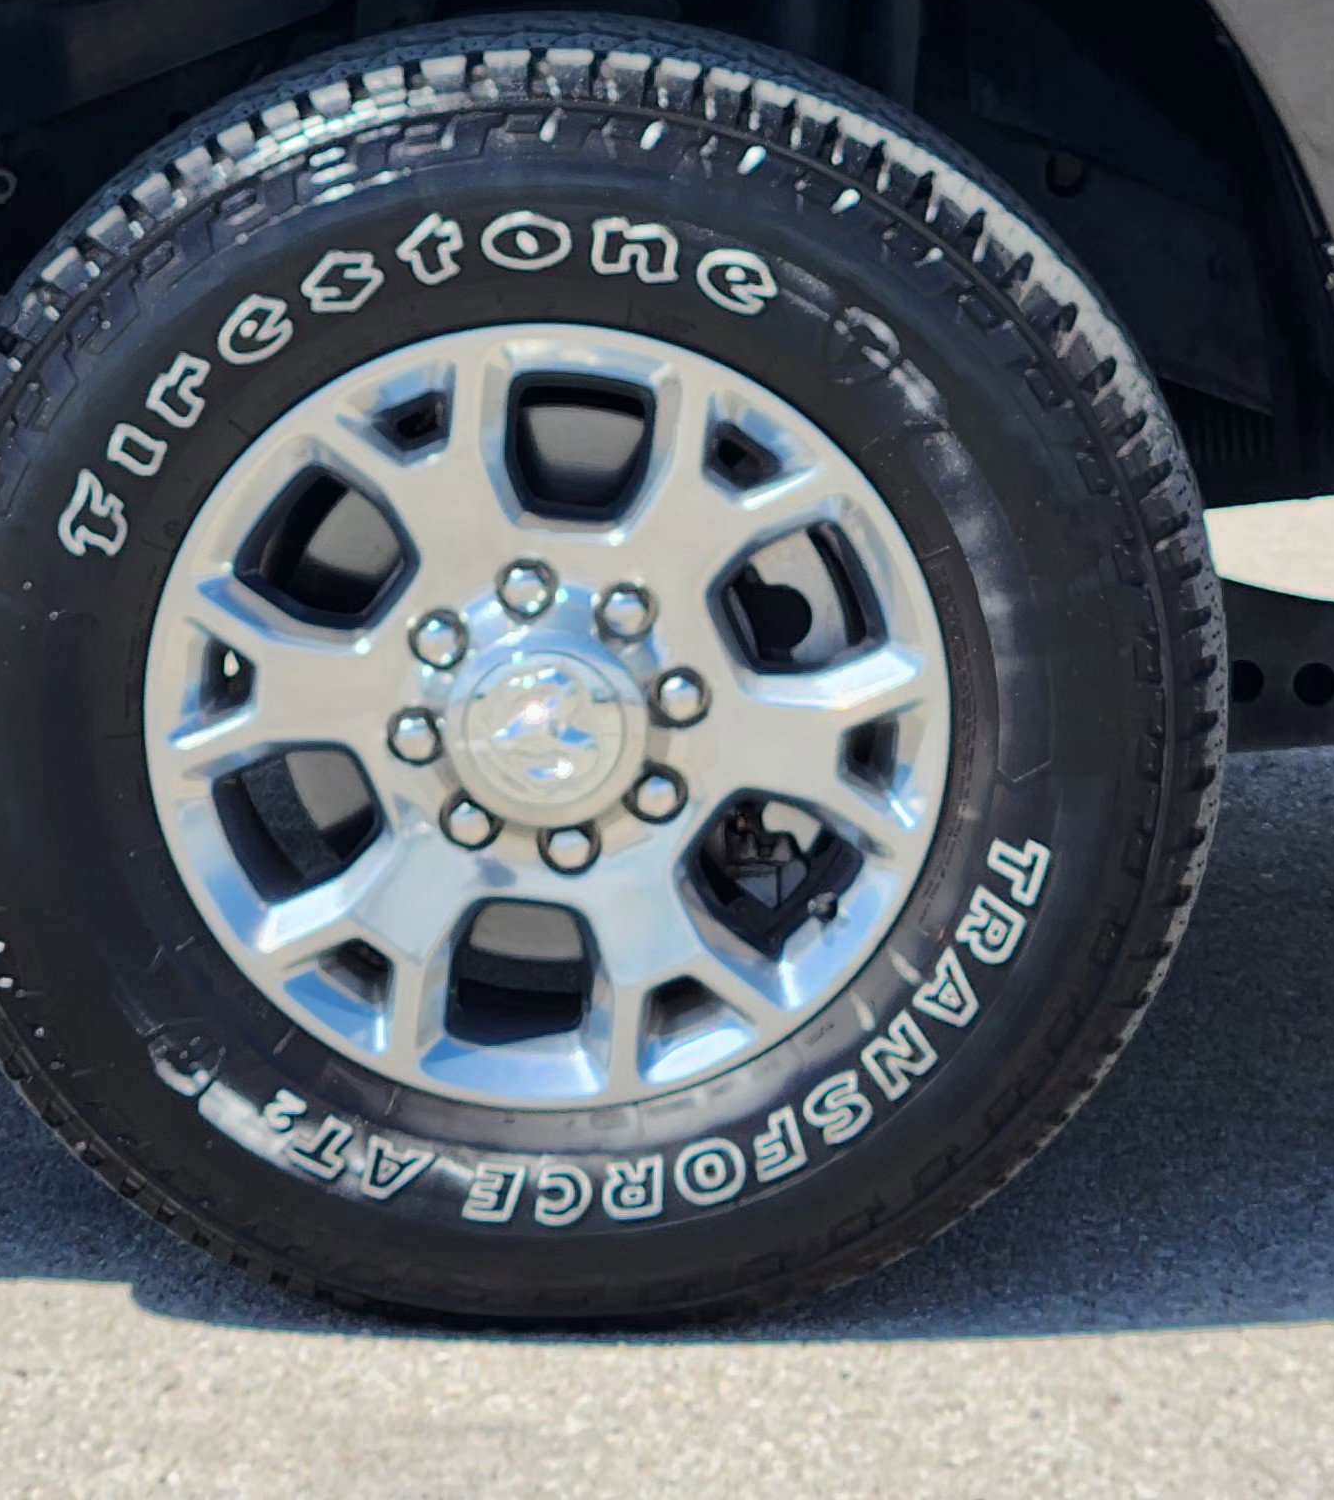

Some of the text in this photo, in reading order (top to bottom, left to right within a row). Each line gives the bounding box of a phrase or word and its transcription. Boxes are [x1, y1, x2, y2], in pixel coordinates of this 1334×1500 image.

[58, 211, 778, 557] Firestone
[264, 837, 1052, 1227] TRANSFORCE AT2
